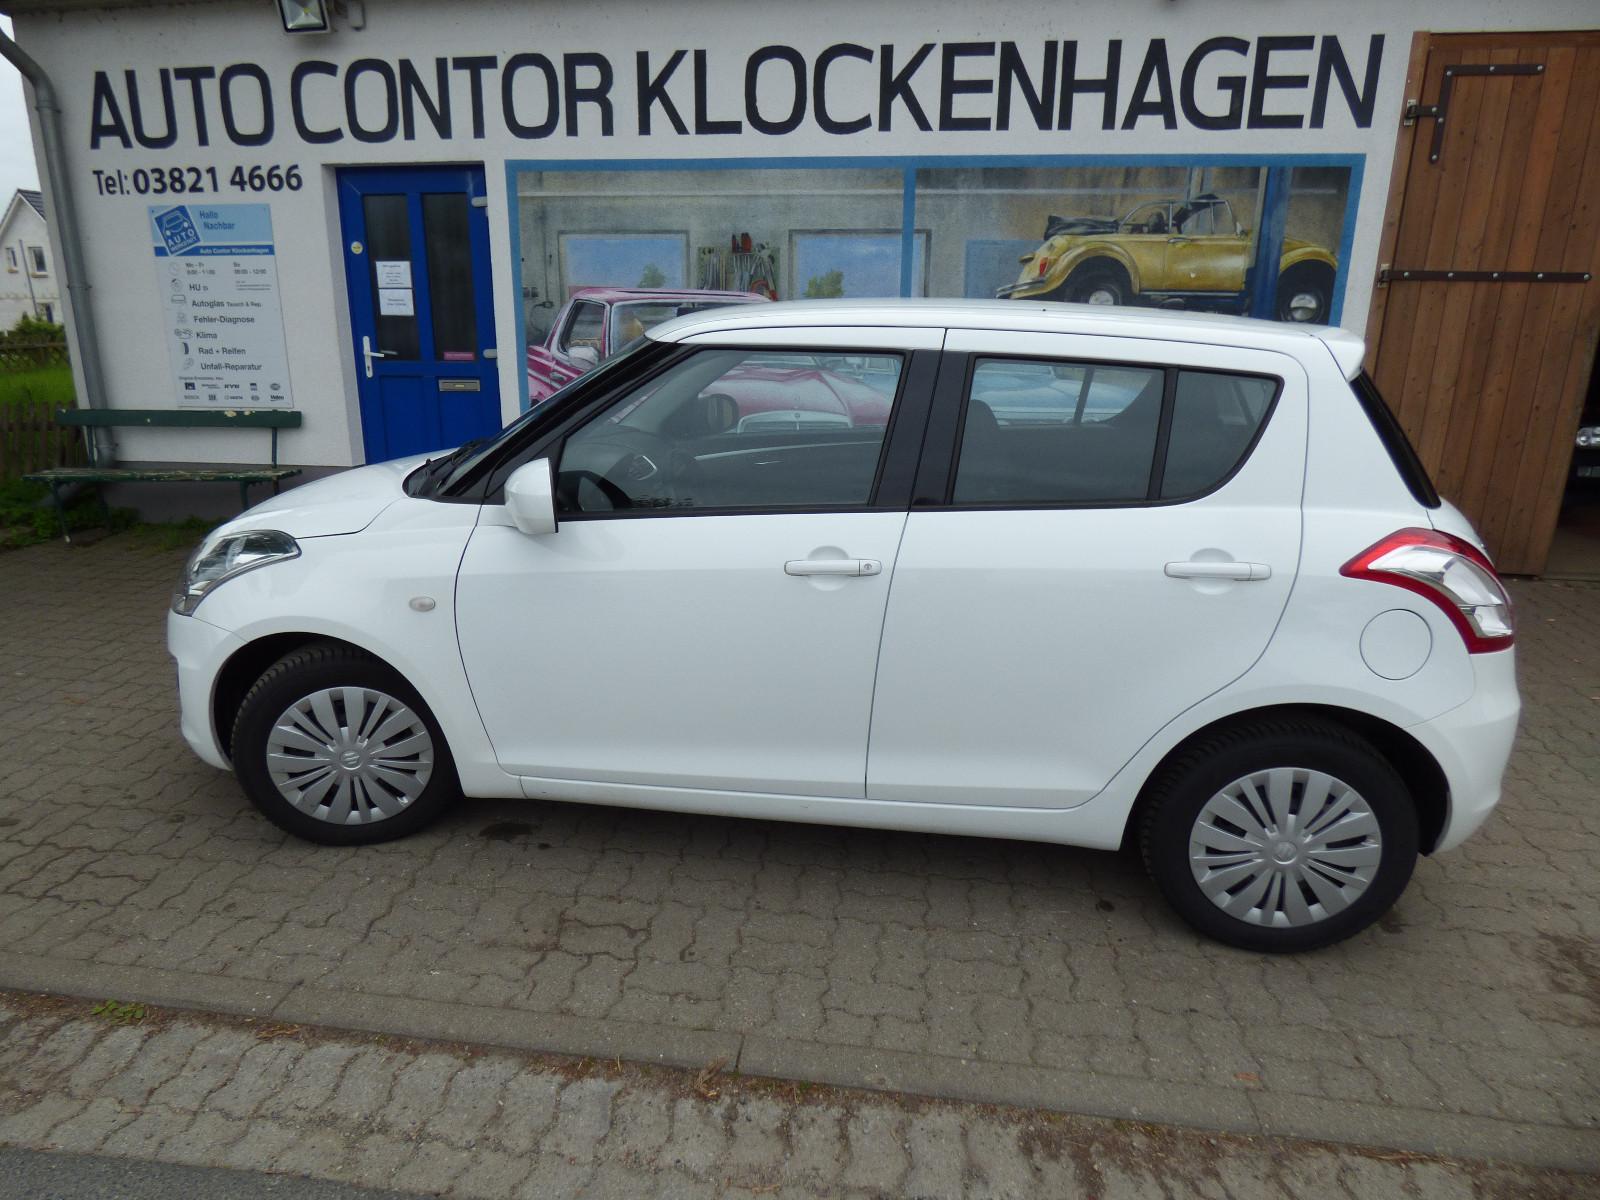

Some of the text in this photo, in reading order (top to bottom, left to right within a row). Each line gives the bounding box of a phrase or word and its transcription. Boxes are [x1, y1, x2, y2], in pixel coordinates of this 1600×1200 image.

[91, 34, 1385, 149] AUTO CONTOR KLOCKENHAGEN
[92, 164, 303, 195] Tel: 03821 4666
[199, 210, 218, 219] Hallo
[203, 221, 236, 231] Nachbar
[167, 229, 195, 248] AUTO
[192, 300, 225, 309] Autoglas
[193, 315, 256, 325] Fehler-Diagnose
[196, 331, 218, 340] Klima
[198, 346, 214, 355] Rad
[222, 346, 247, 355] Reifen
[201, 362, 263, 372] Unfall-Reparatur
